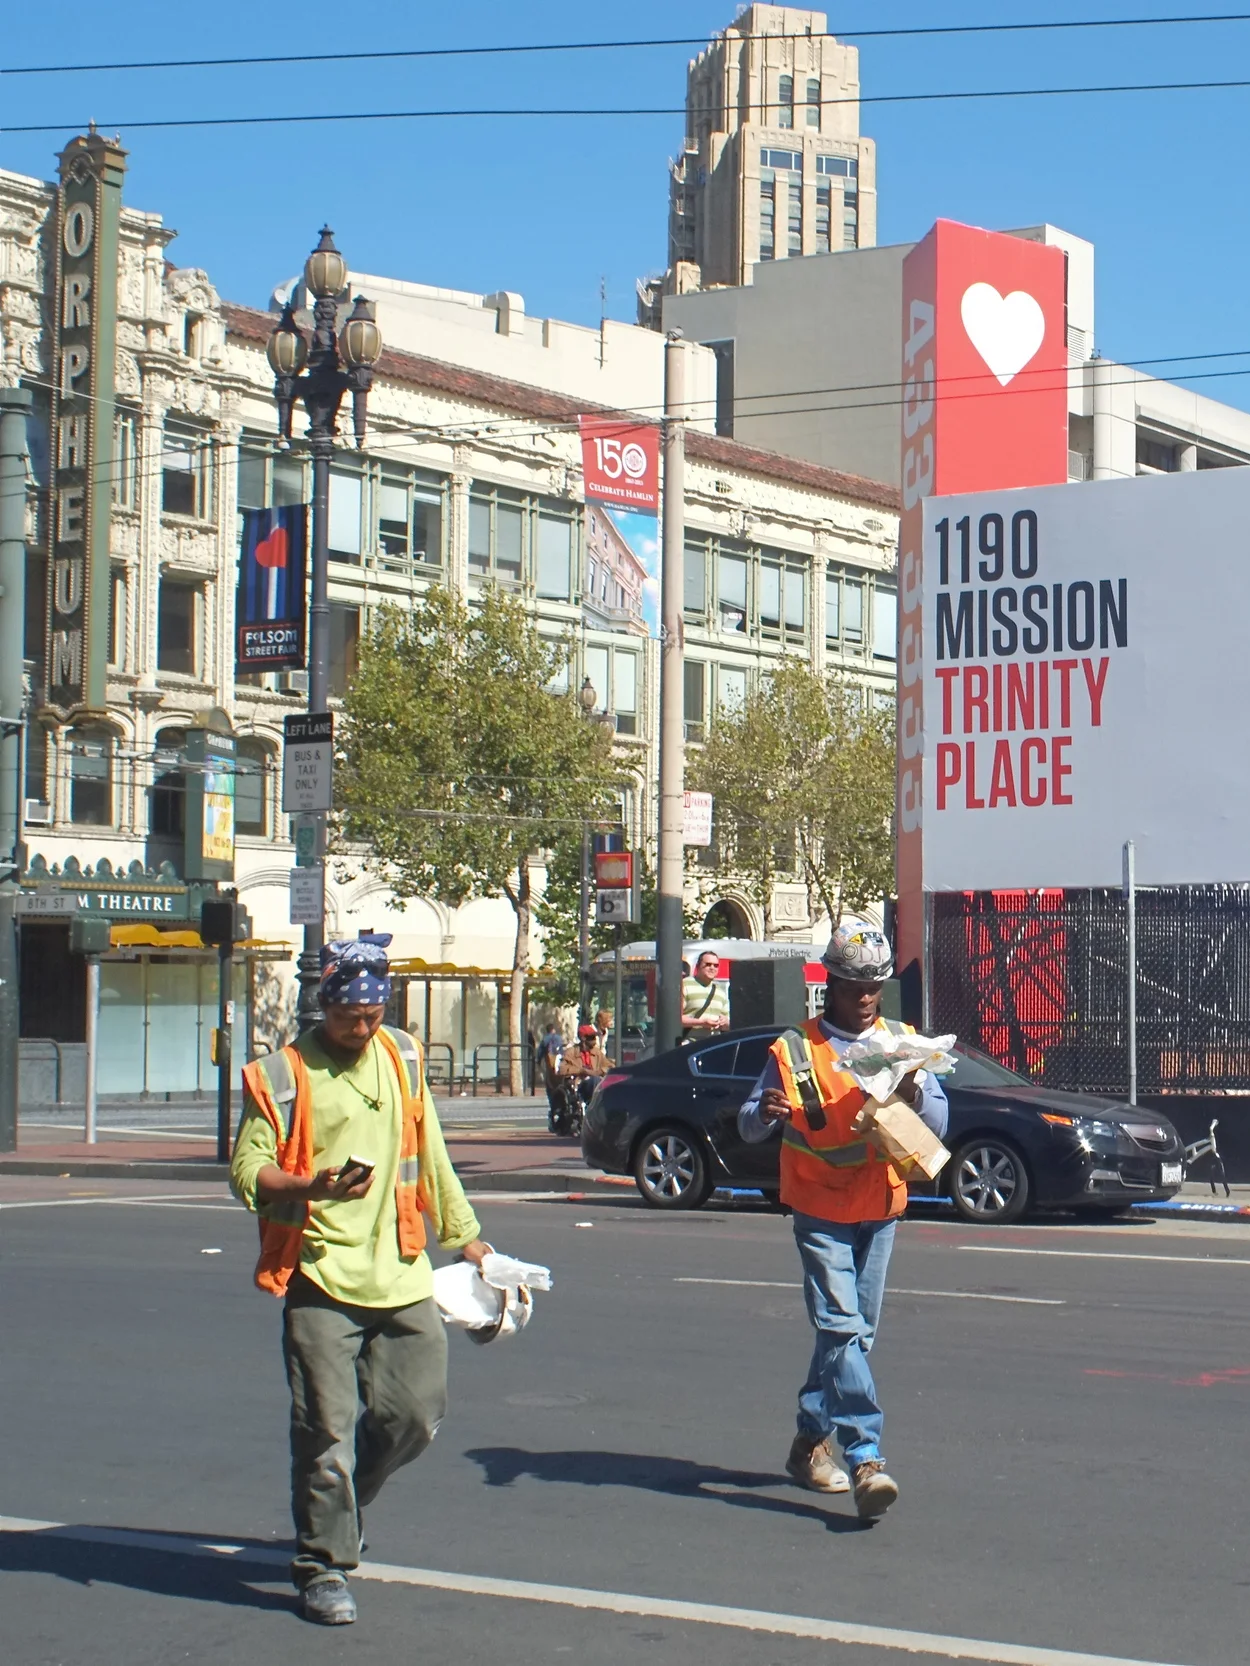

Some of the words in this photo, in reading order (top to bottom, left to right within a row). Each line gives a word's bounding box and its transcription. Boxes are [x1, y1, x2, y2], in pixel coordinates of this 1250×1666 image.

[53, 202, 94, 686] ORPHEUM
[593, 437, 647, 479] 150
[589, 482, 625, 497] CELEBRATE
[626, 489, 654, 502] HAMLIN
[934, 509, 1038, 585] 1190
[936, 578, 1128, 660] MISSION
[245, 630, 298, 645] FOLSOM
[245, 645, 277, 657] STREET
[278, 644, 298, 654] FAIR
[935, 656, 1109, 735] TRINITY
[286, 724, 307, 737] LEFT
[308, 722, 331, 736] LANE
[295, 750, 312, 762] BUS
[315, 750, 321, 760] &
[298, 764, 317, 776] TAXI
[936, 735, 1073, 811] PLACE
[295, 779, 319, 790] ONLY
[27, 898, 47, 910] 8TH
[54, 897, 65, 909] ST
[97, 894, 172, 912] THEATRE
[768, 948, 789, 957] Hybrid
[790, 948, 812, 958] Electric
